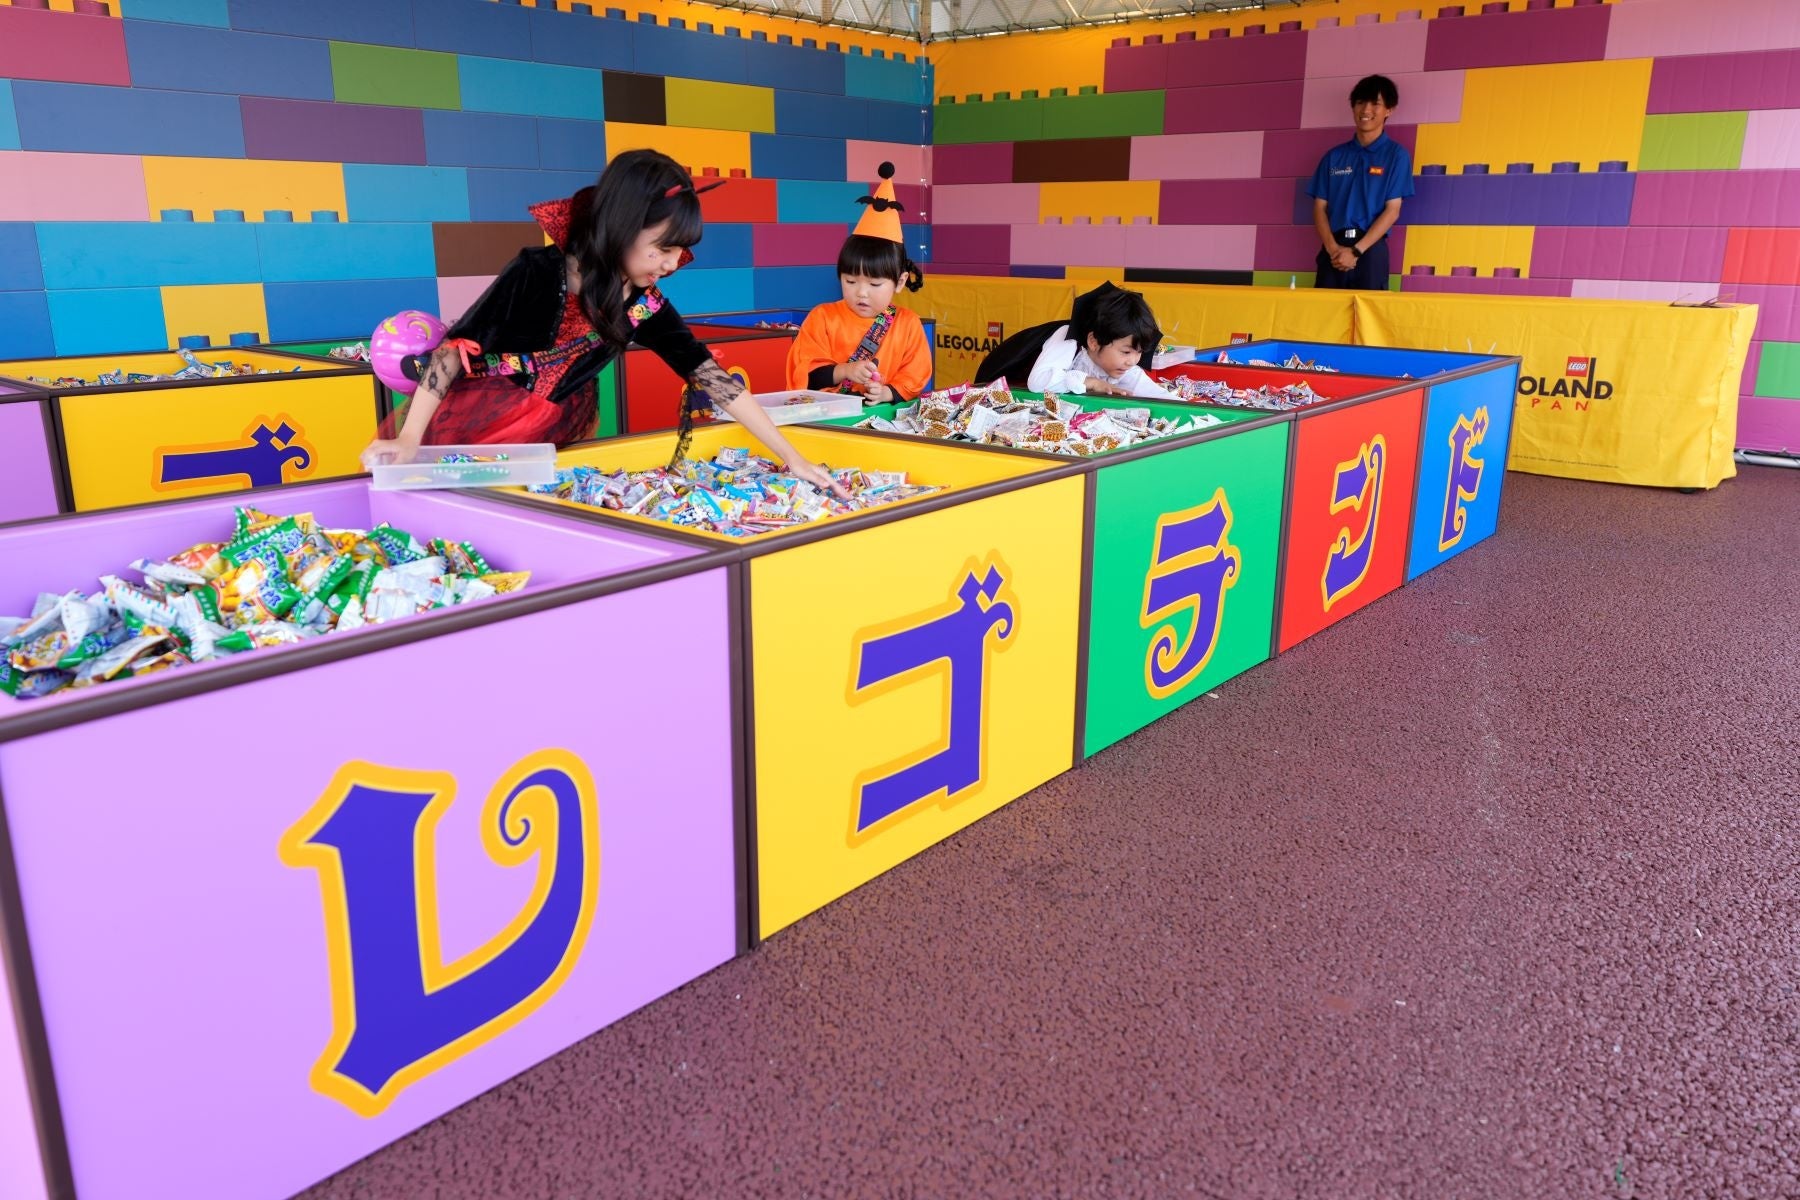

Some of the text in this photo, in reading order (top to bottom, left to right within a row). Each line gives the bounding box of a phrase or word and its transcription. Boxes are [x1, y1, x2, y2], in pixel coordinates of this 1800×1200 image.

[937, 322, 1004, 352] LEGOLAN
[948, 351, 987, 360] JAP
[1567, 361, 1588, 372] LEGO
[1517, 357, 1613, 400] OLAND
[1530, 398, 1589, 411] PAN
